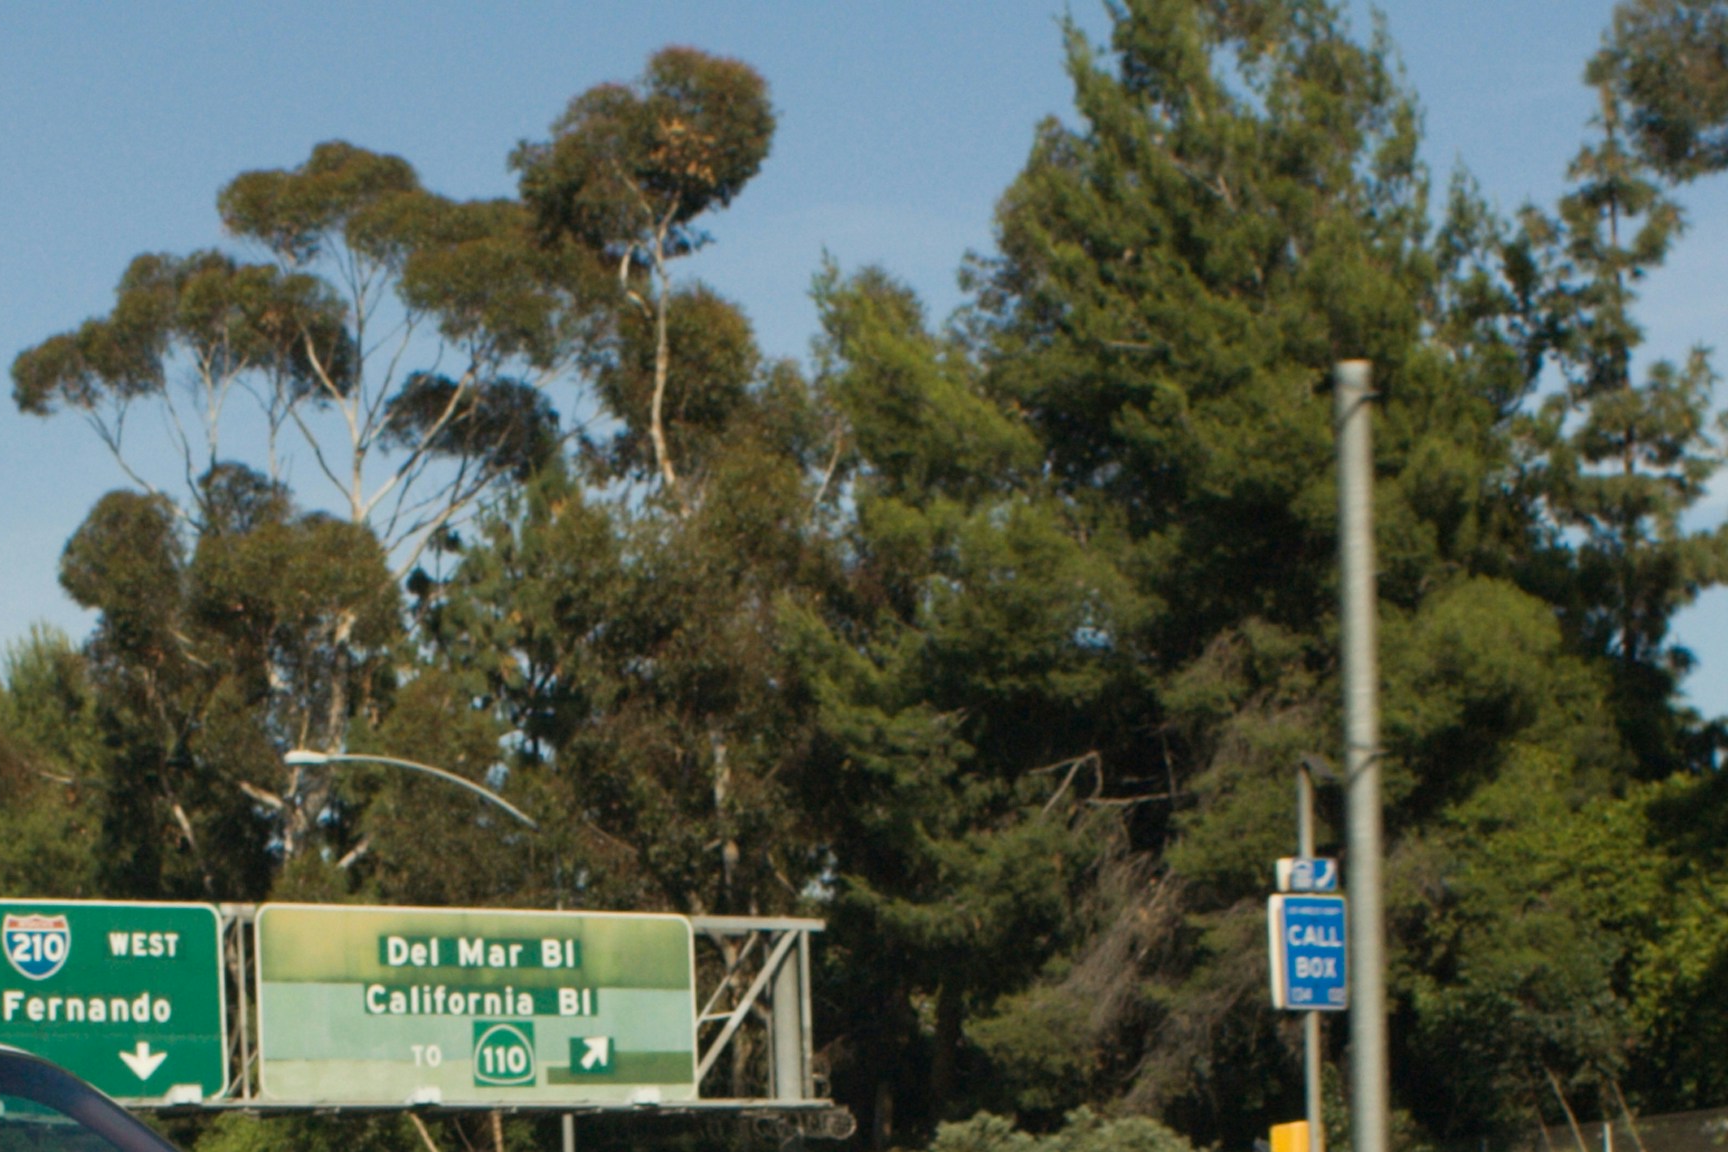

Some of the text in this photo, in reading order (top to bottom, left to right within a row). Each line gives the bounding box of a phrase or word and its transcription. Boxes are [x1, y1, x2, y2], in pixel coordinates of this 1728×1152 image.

[12, 933, 64, 961] 210
[109, 933, 179, 957] WEST
[1288, 925, 1342, 947] CALL
[388, 936, 574, 968] Del Mar Bl
[1295, 956, 1337, 978] BOX
[3, 991, 171, 1023] Fernando
[367, 985, 591, 1016] California Bl
[411, 1044, 442, 1067] TO
[483, 1046, 526, 1073] 110
